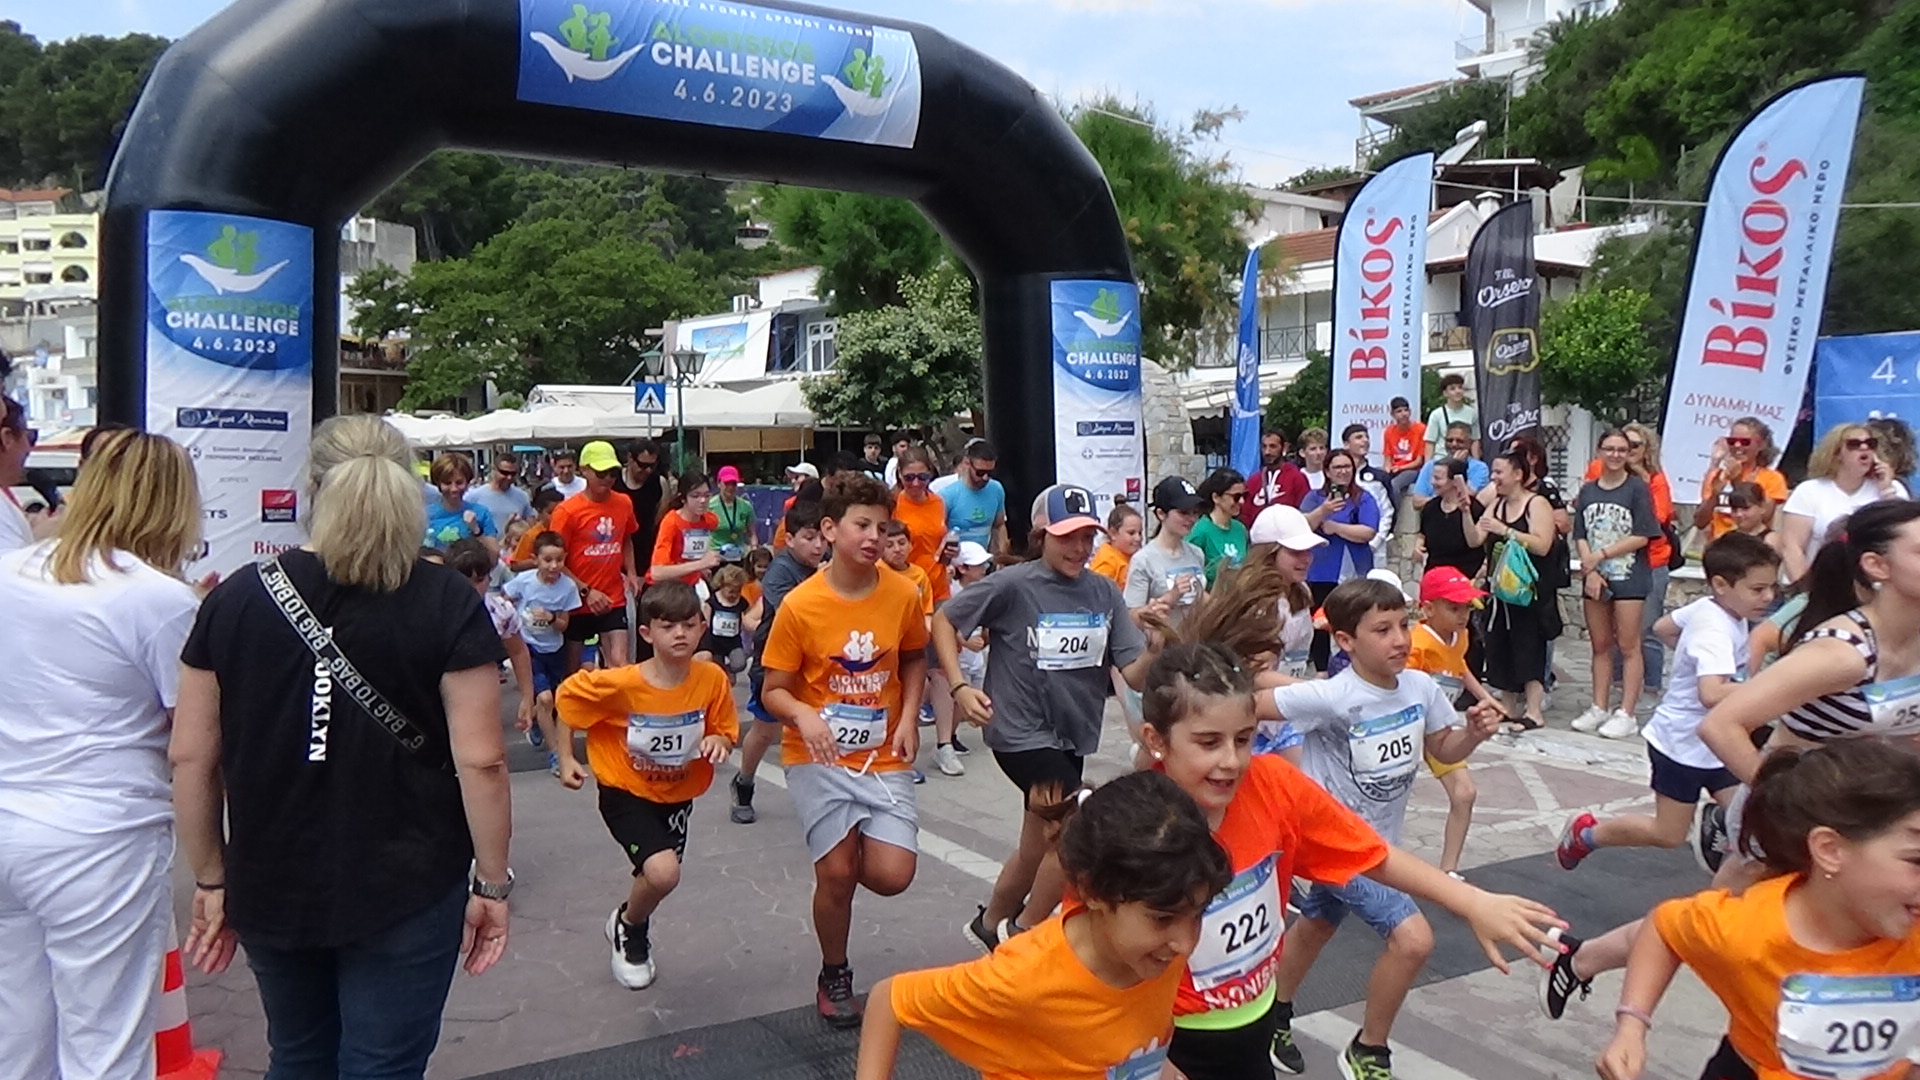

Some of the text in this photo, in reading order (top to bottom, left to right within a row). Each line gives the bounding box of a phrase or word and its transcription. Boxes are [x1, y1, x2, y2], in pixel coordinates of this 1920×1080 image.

[651, 41, 816, 87] CHALLENGE
[673, 78, 794, 114] 4.6.2023
[1700, 155, 1808, 373] Βίκος
[1783, 159, 1831, 375] ΦΥΣΙΚΟ ΜΕΤΑΛΛΙΚΟ ΝΕΡΟ
[1348, 216, 1404, 382] Βίκος
[1477, 277, 1534, 308] Orsero
[166, 311, 299, 336] CHALLENGE
[193, 336, 277, 354] 4.6.2023
[1066, 351, 1137, 366] CHALLENGE
[1084, 369, 1129, 380] 4.6.2023
[1871, 355, 1920, 386] 4.
[1684, 392, 1785, 421] ΔΥΝΑΜΗ ΜΑΣ
[267, 571, 294, 603] BAG
[299, 617, 329, 651] BAG
[1059, 636, 1089, 654] 204
[1890, 704, 1920, 727] 25
[650, 734, 683, 752] 251
[836, 727, 870, 745] 228
[1377, 734, 1412, 764] 205
[1220, 902, 1270, 954] 222
[1827, 1019, 1898, 1054] 209
